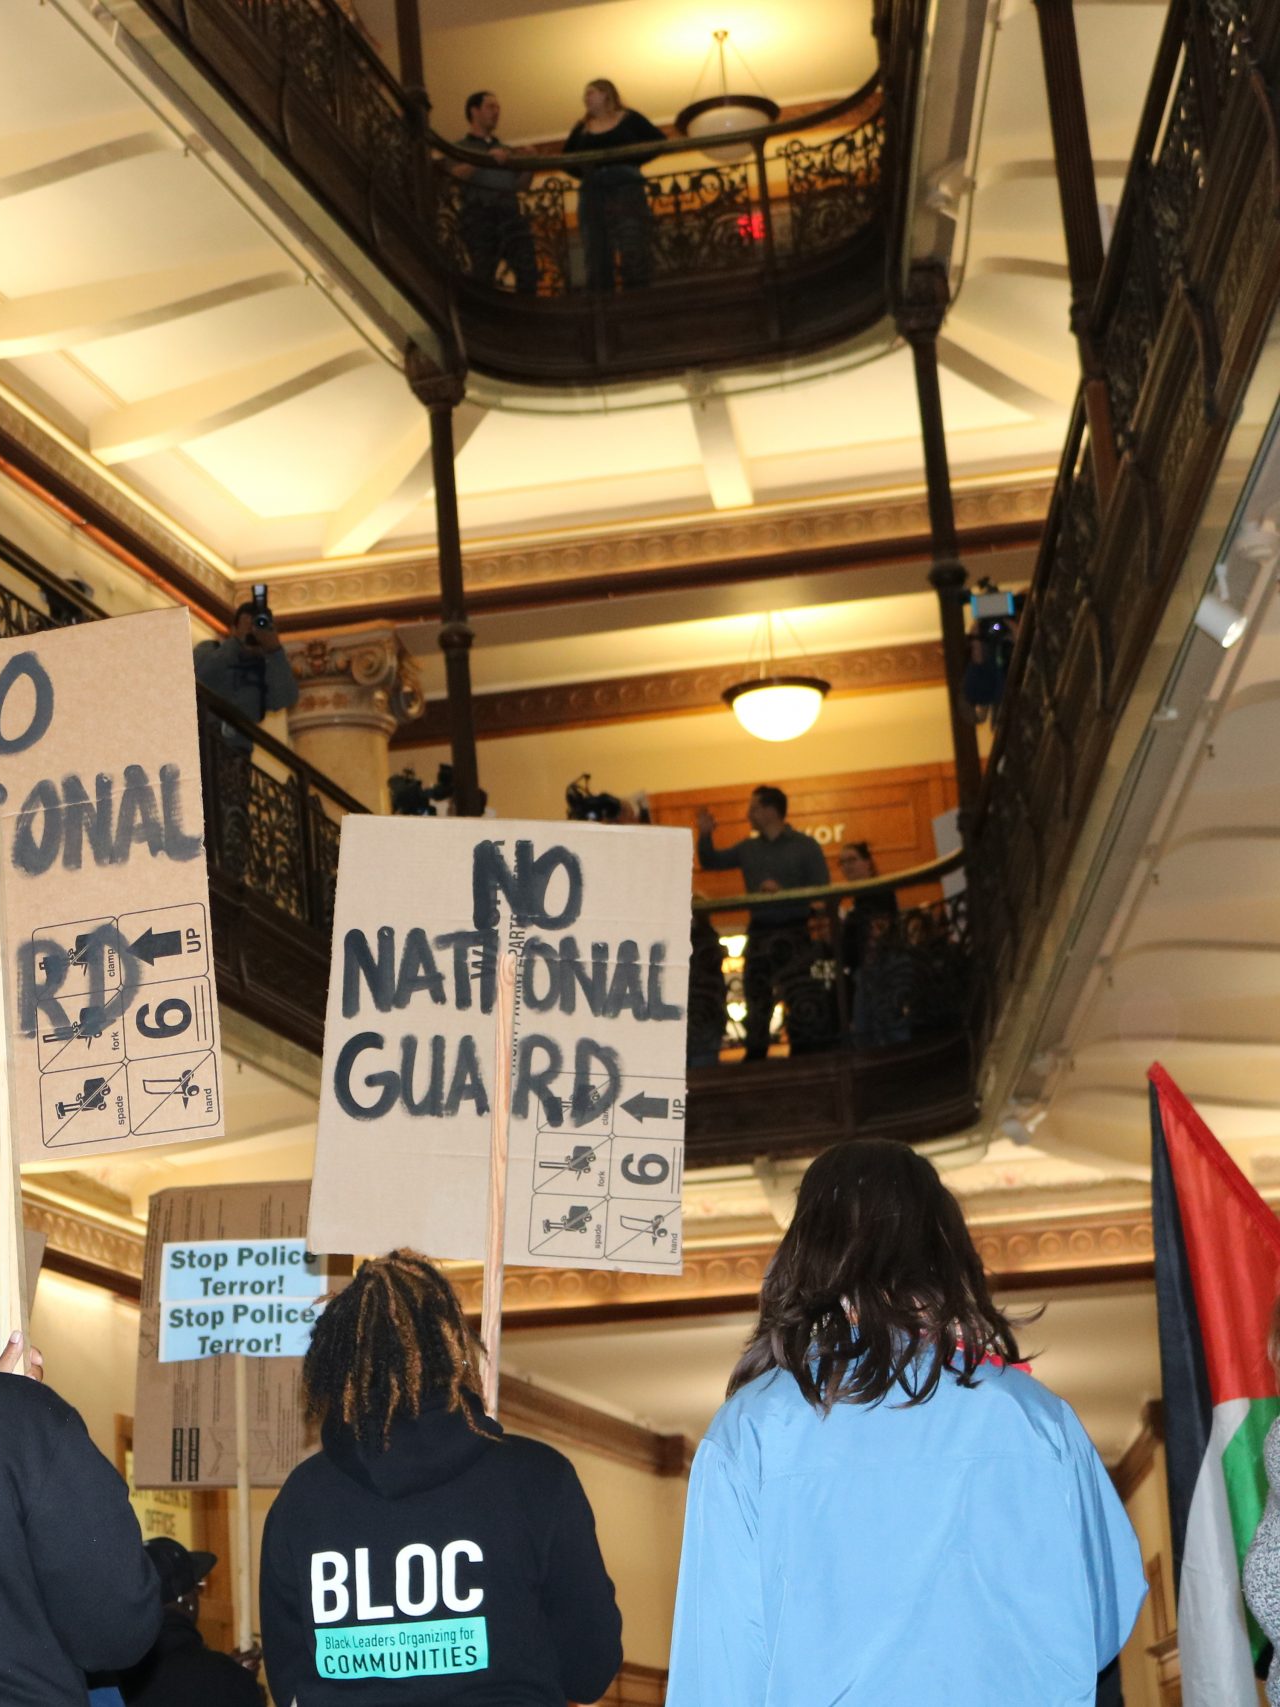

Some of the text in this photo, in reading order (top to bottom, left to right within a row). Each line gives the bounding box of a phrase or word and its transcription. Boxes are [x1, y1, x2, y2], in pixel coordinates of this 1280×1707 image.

[472, 839, 584, 931] NO
[186, 928, 201, 953] UP
[107, 949, 116, 977] clamp
[342, 926, 685, 1021] NATIONAL
[135, 998, 192, 1039] 6
[111, 1031, 120, 1051] fork
[333, 1031, 624, 1128] GUARD
[117, 1095, 125, 1125] spade
[205, 1088, 213, 1113] hand
[672, 1098, 686, 1121] UP
[597, 1171, 606, 1188] fork
[621, 1153, 670, 1185] 6
[594, 1223, 602, 1249] spade
[670, 1232, 678, 1254] hand
[170, 1245, 317, 1271] Stop Police
[200, 1275, 284, 1296] Terror!
[168, 1304, 316, 1330] Stop Police
[197, 1333, 282, 1355] Terror!
[310, 1539, 484, 1623] BLOC
[324, 1627, 475, 1650] Black Leaders Organizing for
[323, 1644, 478, 1675] COMMUNITIES
